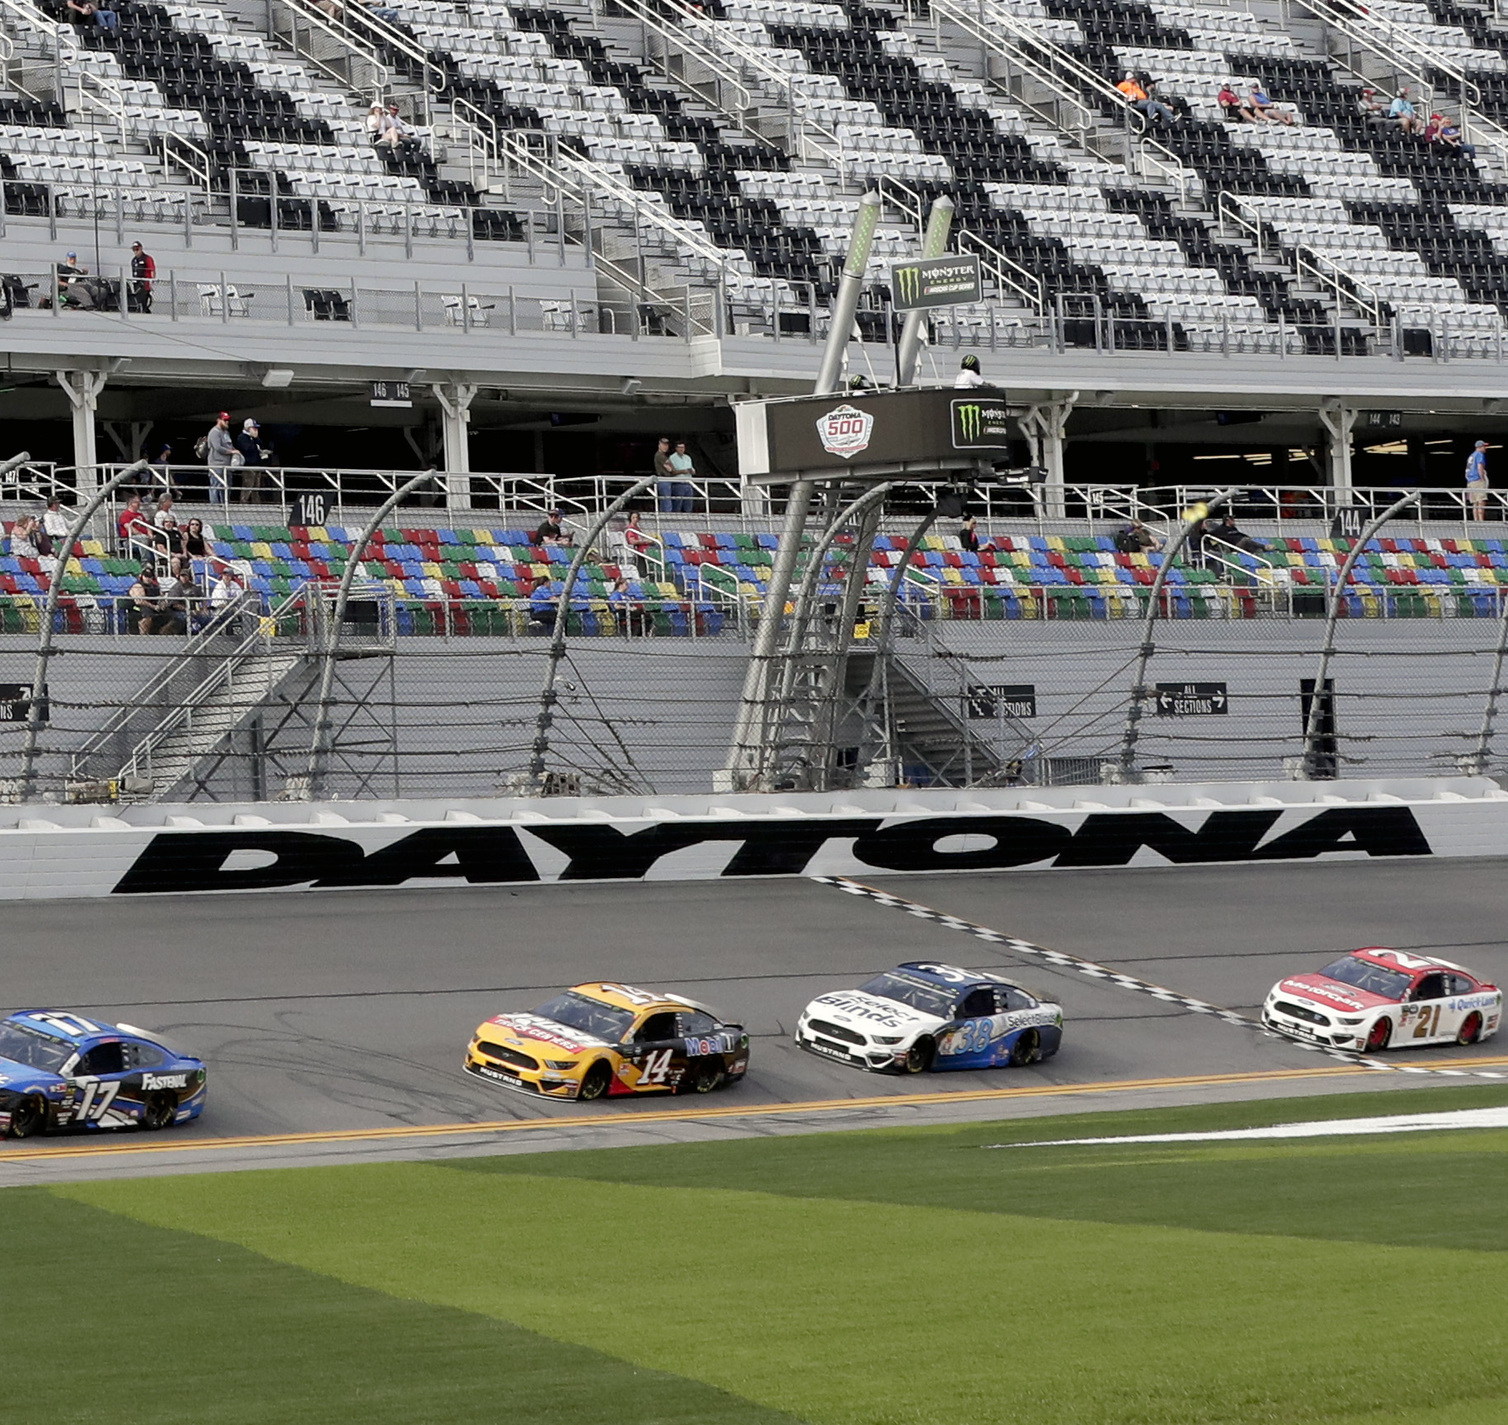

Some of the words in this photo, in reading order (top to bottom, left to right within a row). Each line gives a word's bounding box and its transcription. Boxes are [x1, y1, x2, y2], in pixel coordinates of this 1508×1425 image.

[922, 265, 975, 279] MONSTER
[372, 382, 387, 398] 146
[396, 383, 410, 398] 145
[827, 412, 862, 422] DAYTONA
[827, 419, 864, 436] 500
[299, 494, 325, 525] 146
[1339, 509, 1361, 536] 144
[111, 806, 1434, 894] DAYTONA
[814, 996, 903, 1028] Blinds
[1412, 1004, 1441, 1039] 21
[685, 1035, 726, 1058] Mobil
[955, 1017, 994, 1054] 38
[480, 1066, 523, 1087] MUSTANG
[636, 1048, 674, 1085] 14
[75, 1081, 121, 1121] 17
